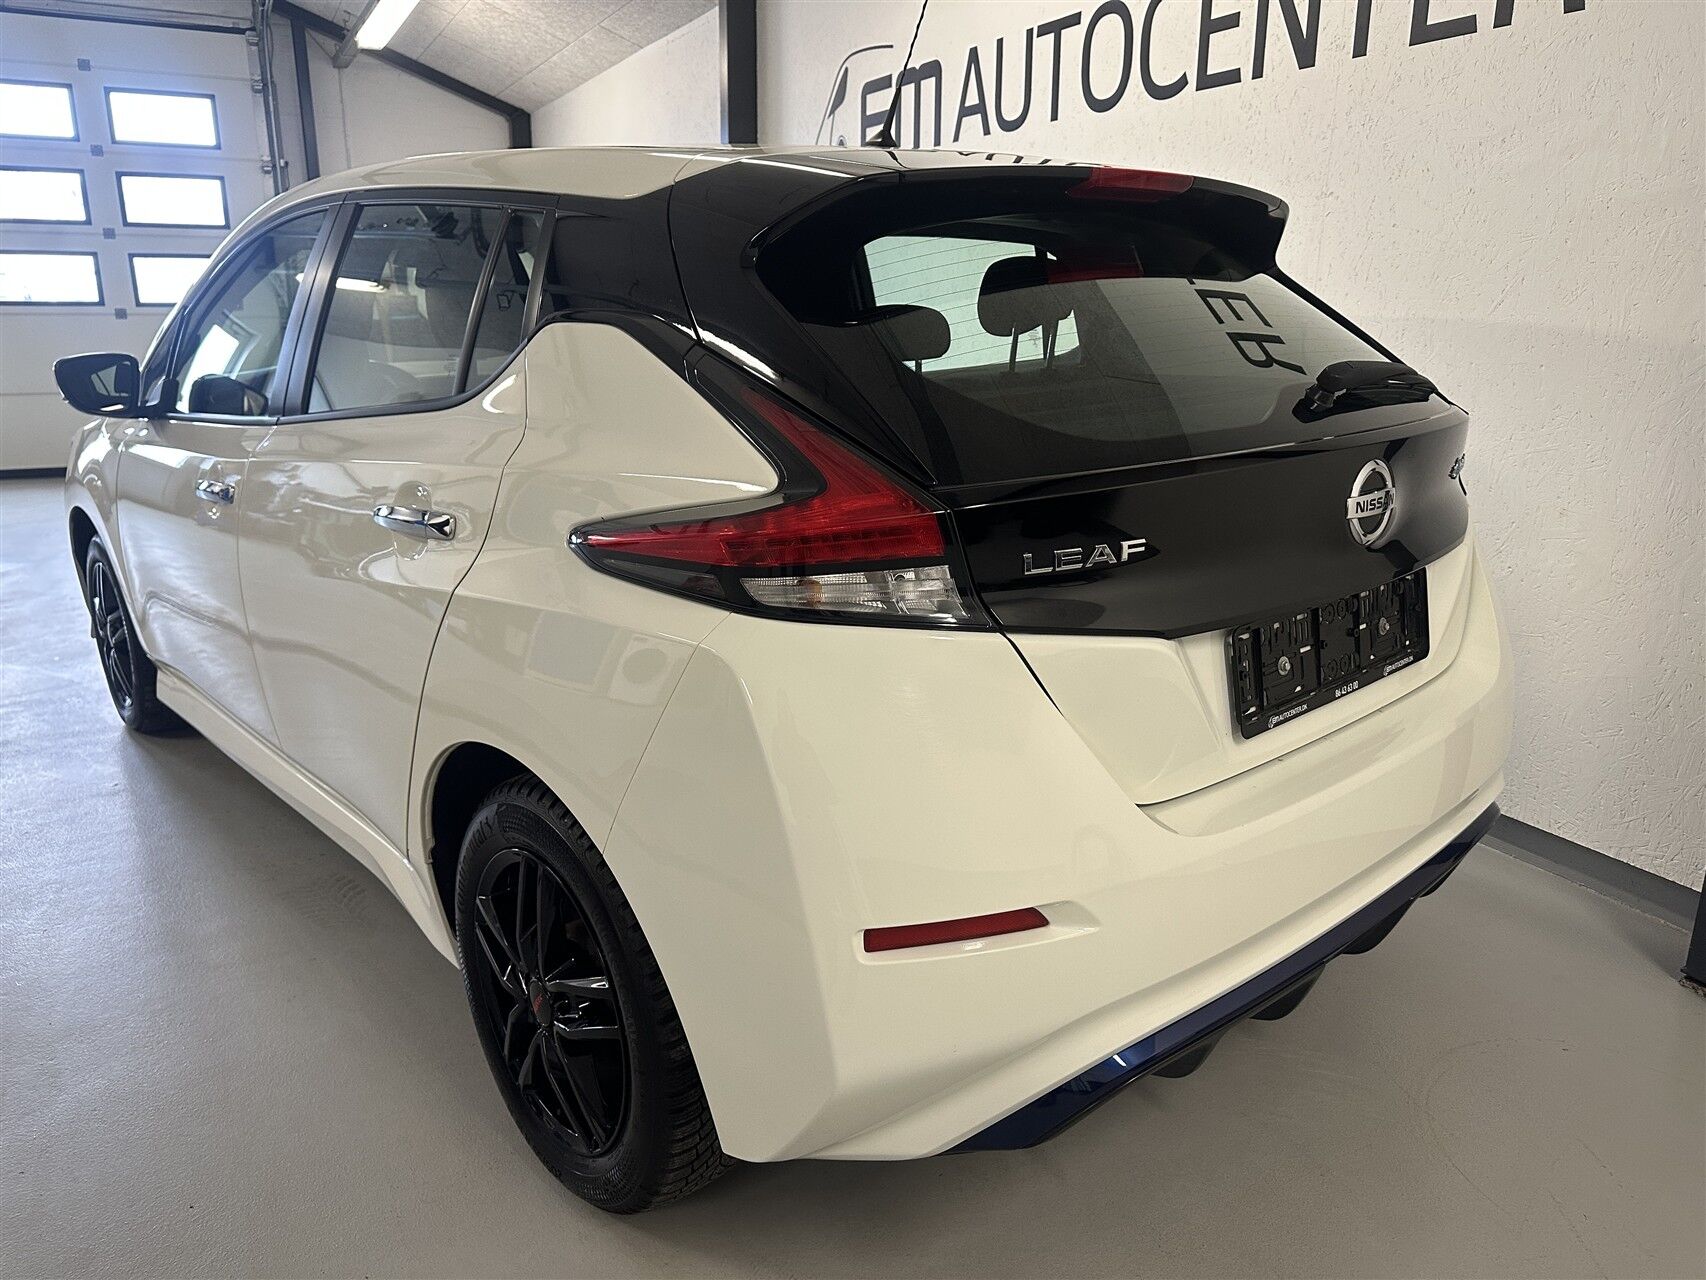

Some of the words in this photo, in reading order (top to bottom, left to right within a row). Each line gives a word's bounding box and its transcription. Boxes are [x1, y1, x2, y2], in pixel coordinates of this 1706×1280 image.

[952, 0, 1586, 143] AUTOCEN
[1355, 490, 1395, 514] NISSAN
[1023, 538, 1147, 576] LEAF
